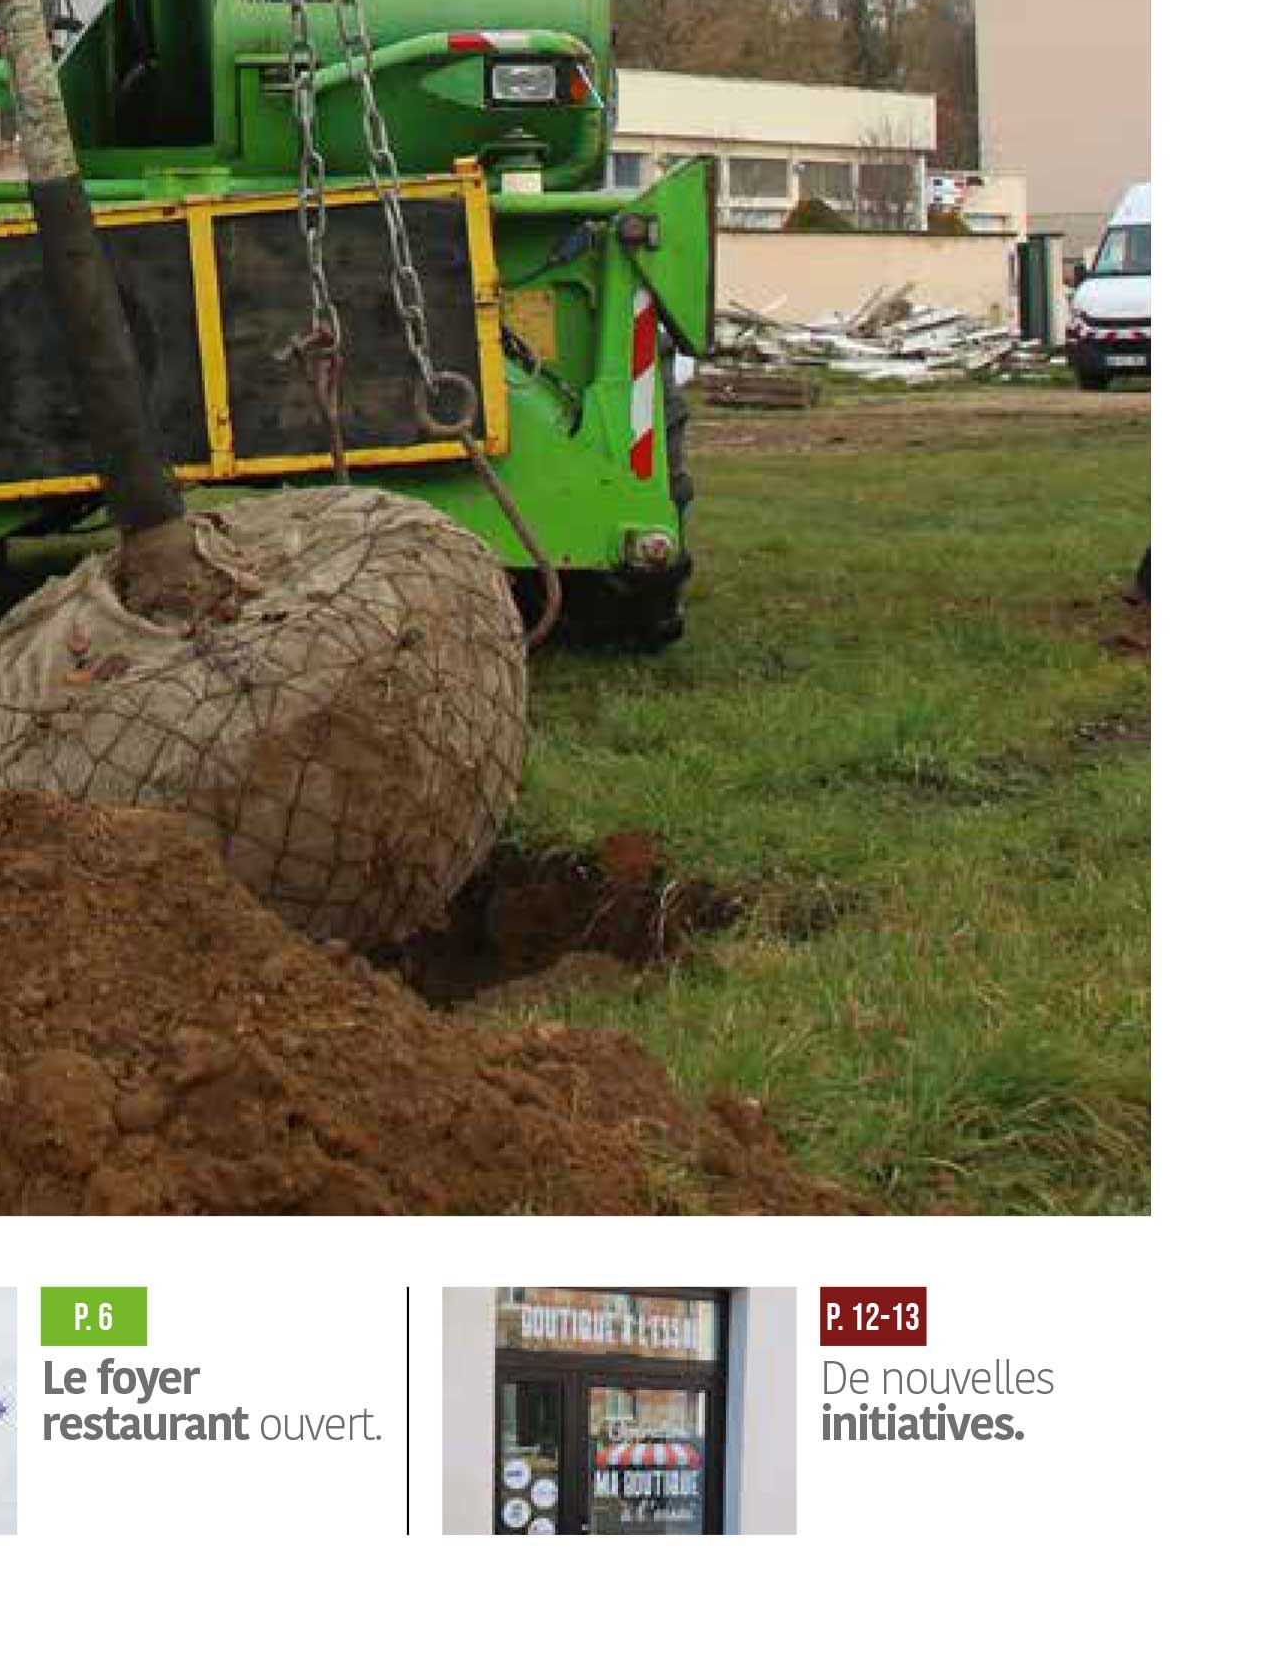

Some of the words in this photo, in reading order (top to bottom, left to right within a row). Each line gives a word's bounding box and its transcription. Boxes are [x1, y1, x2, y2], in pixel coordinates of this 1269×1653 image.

[75, 1302, 91, 1331] P.
[99, 1302, 113, 1331] 6
[827, 1302, 843, 1331] P.
[852, 1302, 919, 1331] 12-13
[44, 1360, 87, 1395] Le
[96, 1357, 201, 1405] foyer
[823, 1360, 869, 1395] De
[883, 1358, 1054, 1395] nouvelles
[43, 1406, 251, 1441] restaurant
[260, 1408, 382, 1441] ouvert.
[822, 1402, 1025, 1441] initiatives.
